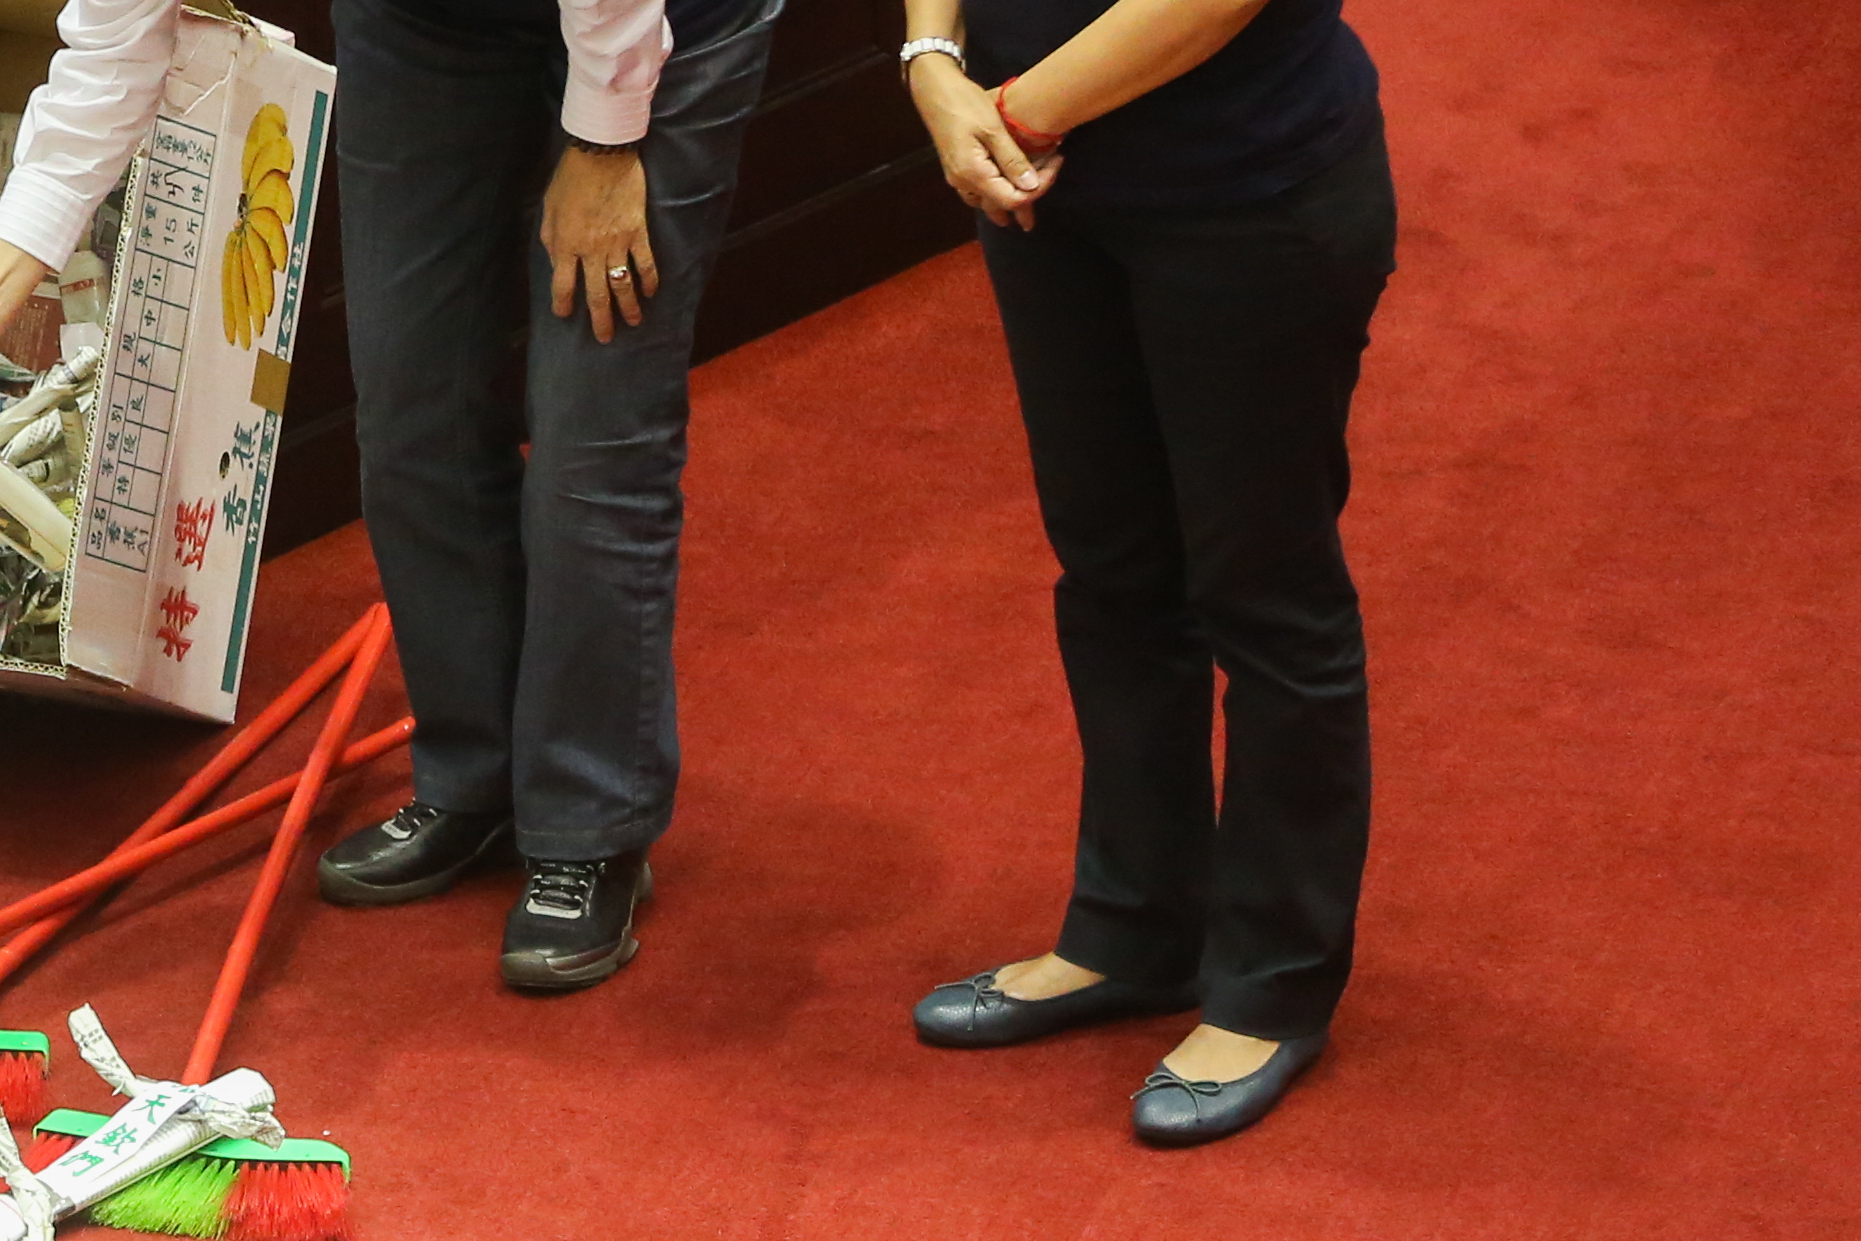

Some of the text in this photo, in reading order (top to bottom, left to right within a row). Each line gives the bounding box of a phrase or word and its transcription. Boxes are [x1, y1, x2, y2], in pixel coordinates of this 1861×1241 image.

[163, 218, 177, 246] 15
[183, 217, 200, 259] 公斤
[144, 309, 157, 326] 中
[138, 353, 151, 373] 大
[222, 421, 260, 537] 香蕉
[91, 507, 107, 549] 品名
[155, 497, 216, 663] 特選
